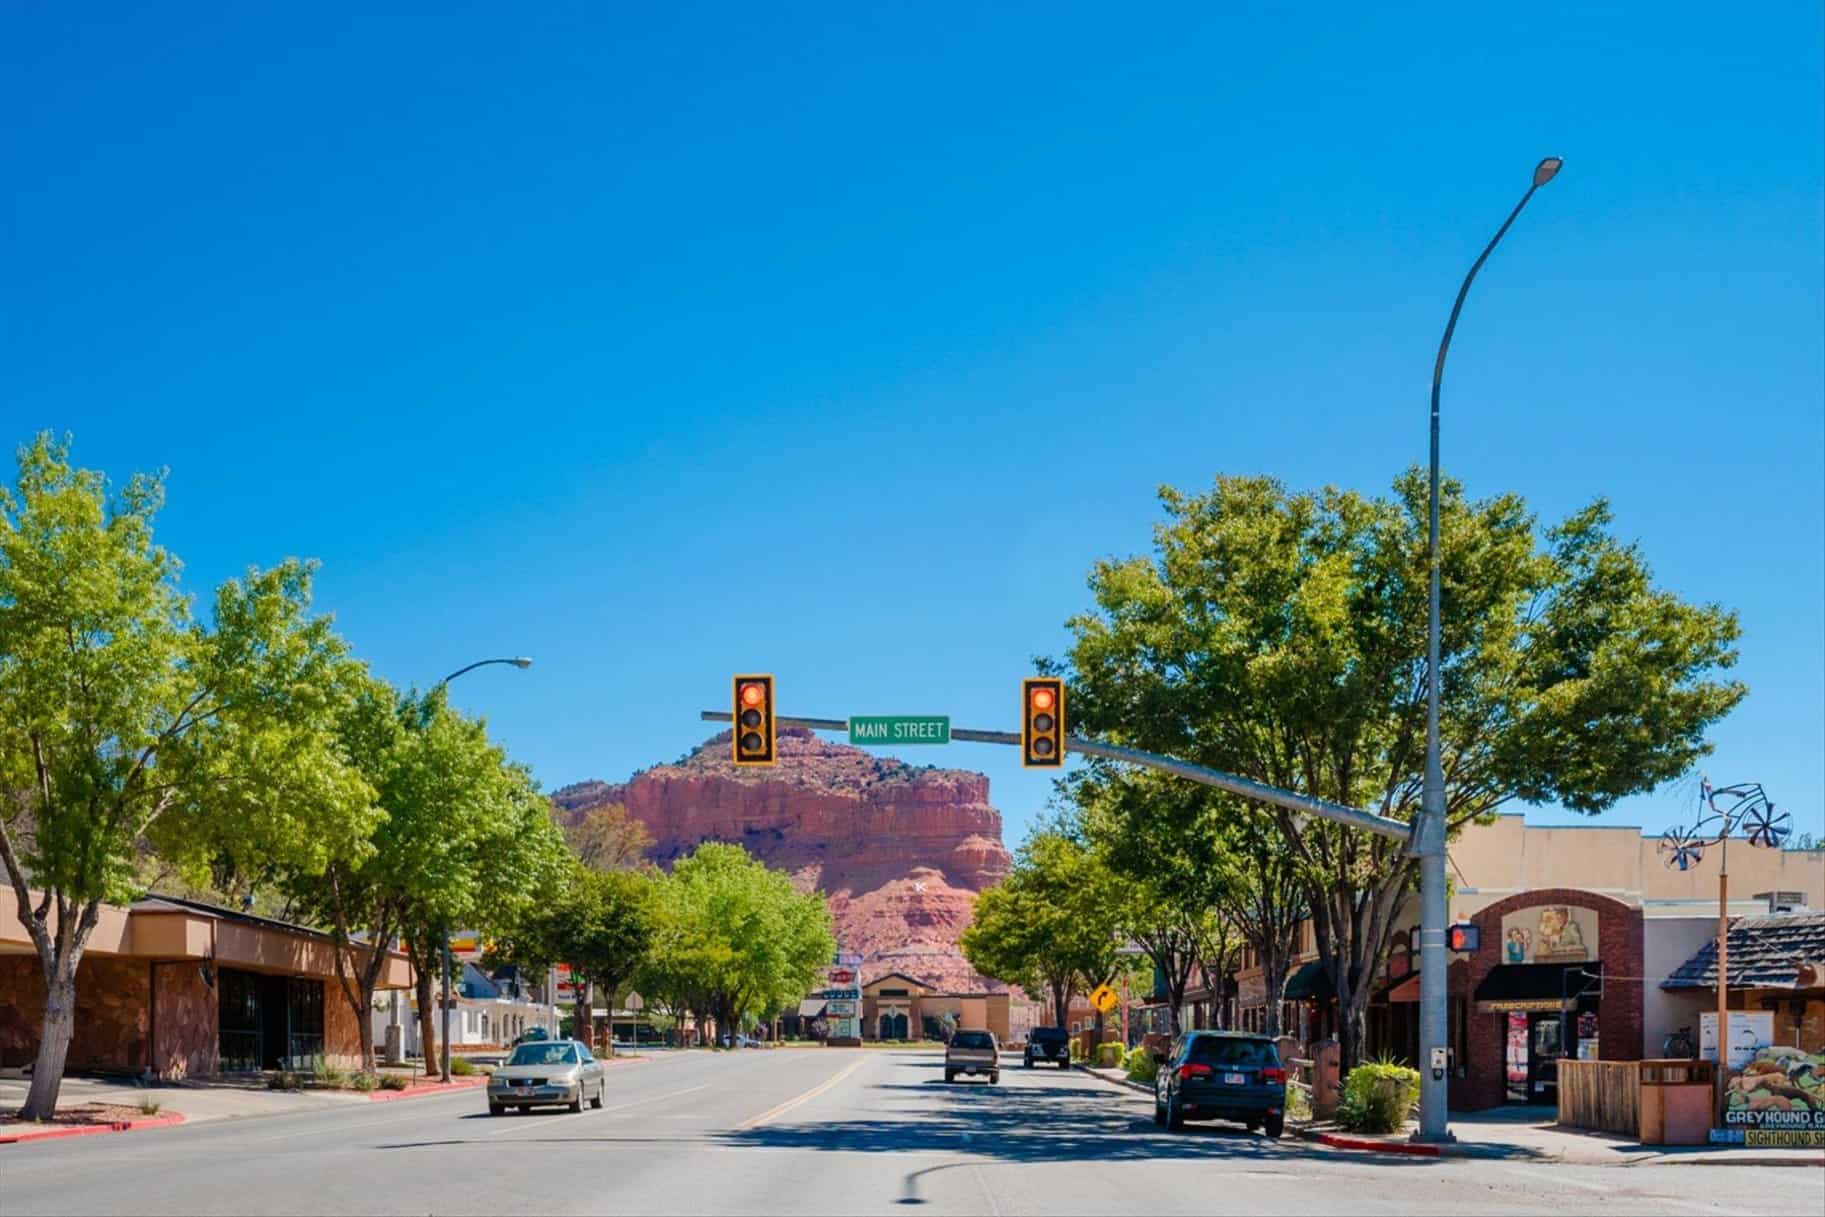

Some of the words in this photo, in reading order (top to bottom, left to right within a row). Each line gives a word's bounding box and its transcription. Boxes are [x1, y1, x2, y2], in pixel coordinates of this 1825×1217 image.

[855, 722, 888, 738] MAIN
[894, 721, 944, 738] STREET
[1726, 1111, 1810, 1123] GREYHOUND
[1748, 1131, 1811, 1145] SIGHTHOUND
